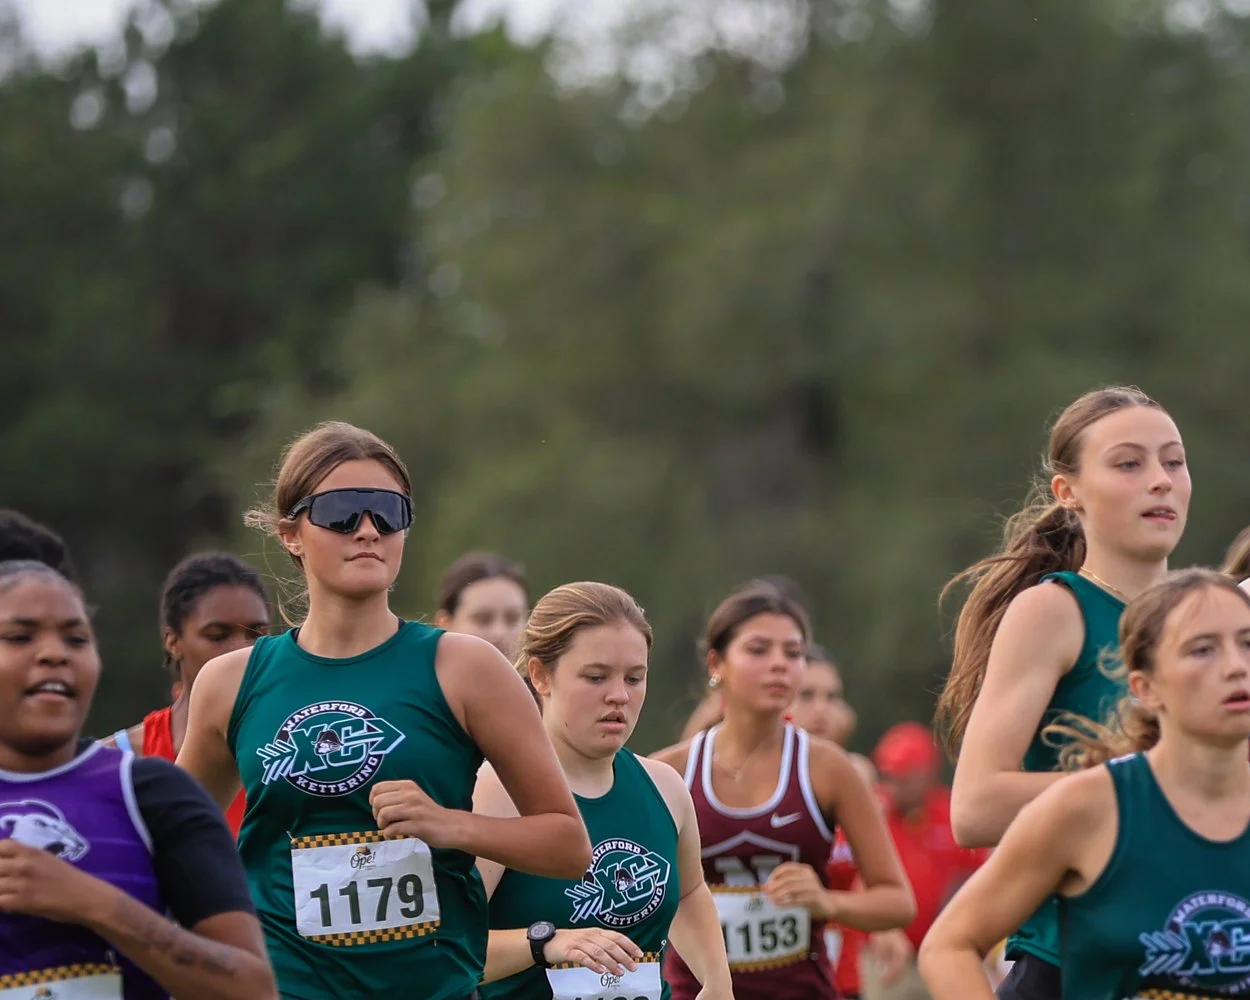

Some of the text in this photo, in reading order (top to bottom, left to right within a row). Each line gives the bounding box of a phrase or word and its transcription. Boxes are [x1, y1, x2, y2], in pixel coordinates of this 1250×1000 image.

[283, 703, 367, 732] WATERFORD
[296, 757, 379, 793] KETTERING
[351, 852, 377, 869] Ope!
[310, 873, 425, 927] 1179
[603, 886, 664, 926] KETTERING
